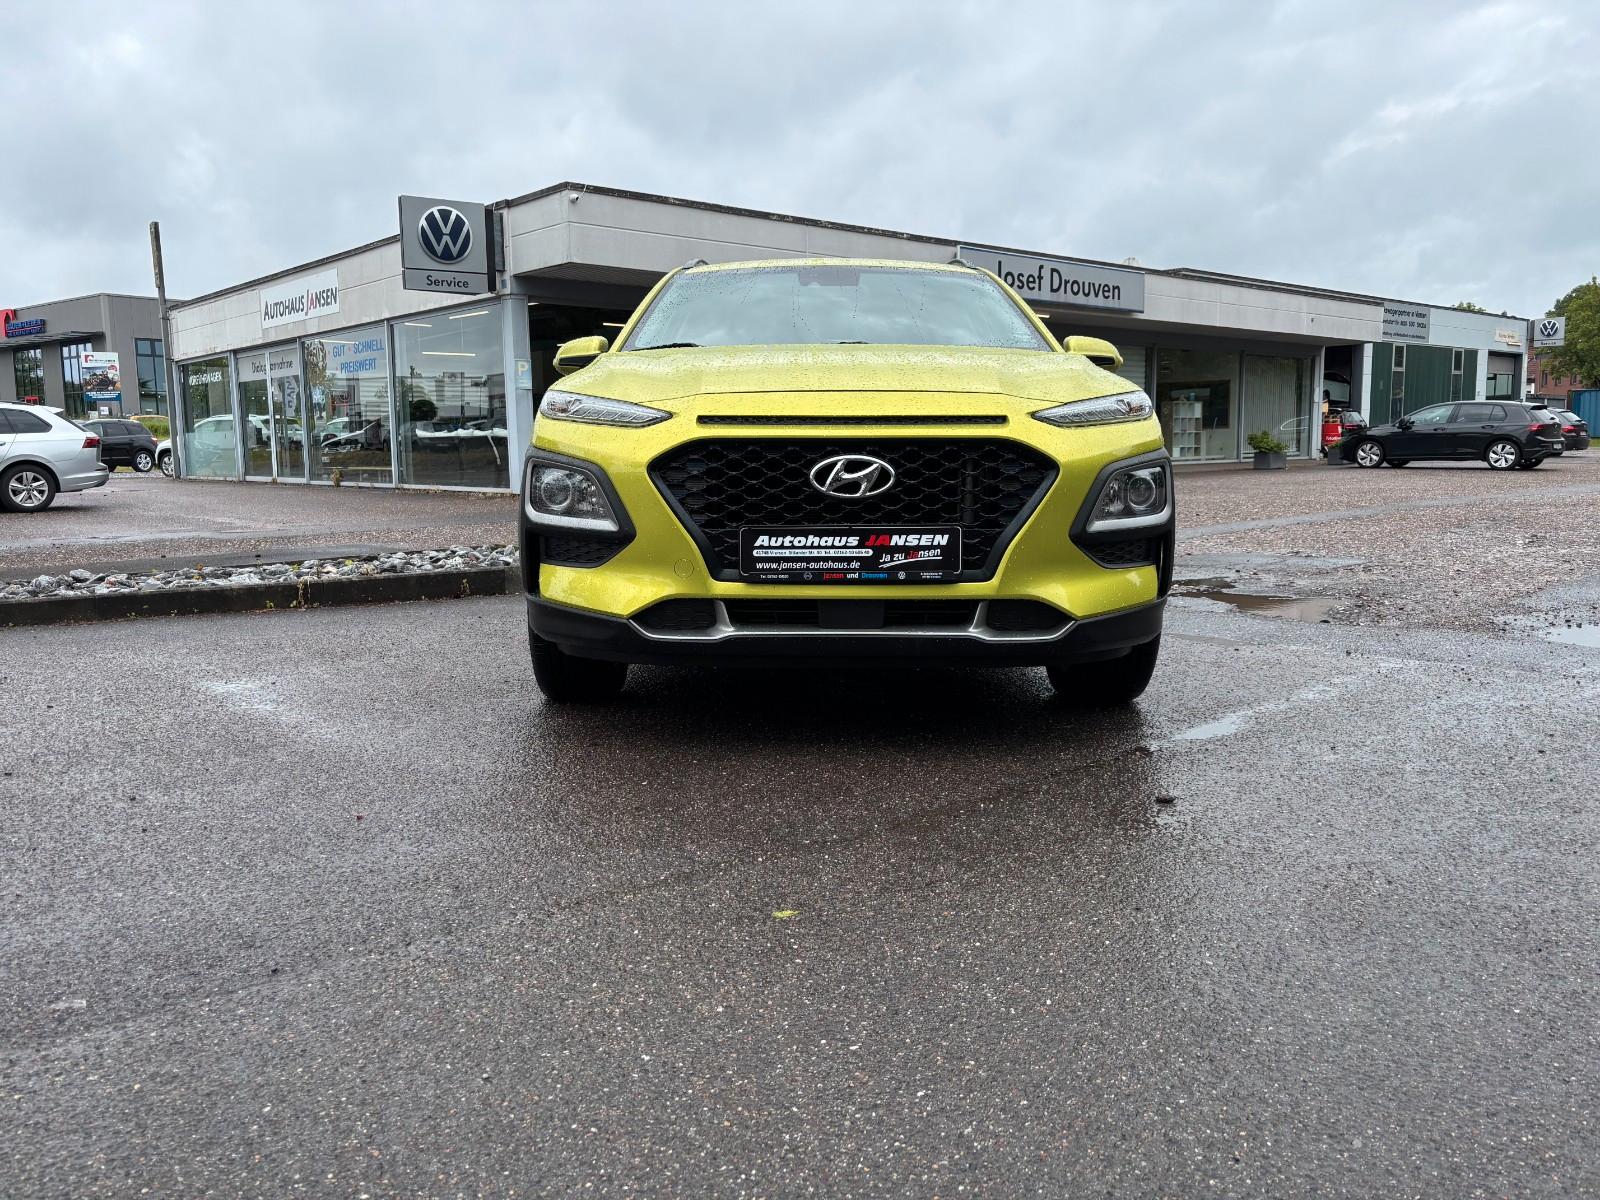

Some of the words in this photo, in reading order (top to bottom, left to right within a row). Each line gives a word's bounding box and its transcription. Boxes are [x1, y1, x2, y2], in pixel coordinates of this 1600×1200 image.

[426, 274, 469, 289] Service
[997, 260, 1044, 292] Josef
[1050, 267, 1121, 300] Drouven
[332, 344, 346, 358] GUT
[353, 338, 385, 354] SCHNELL
[340, 358, 377, 374] PREISWERT
[753, 534, 860, 547] Autohaus
[865, 534, 950, 546] JANSEN
[879, 553, 891, 563] Ja
[893, 552, 905, 561] zu
[907, 548, 941, 559] Jansen
[755, 560, 861, 571] www.jansen-autohaus.de
